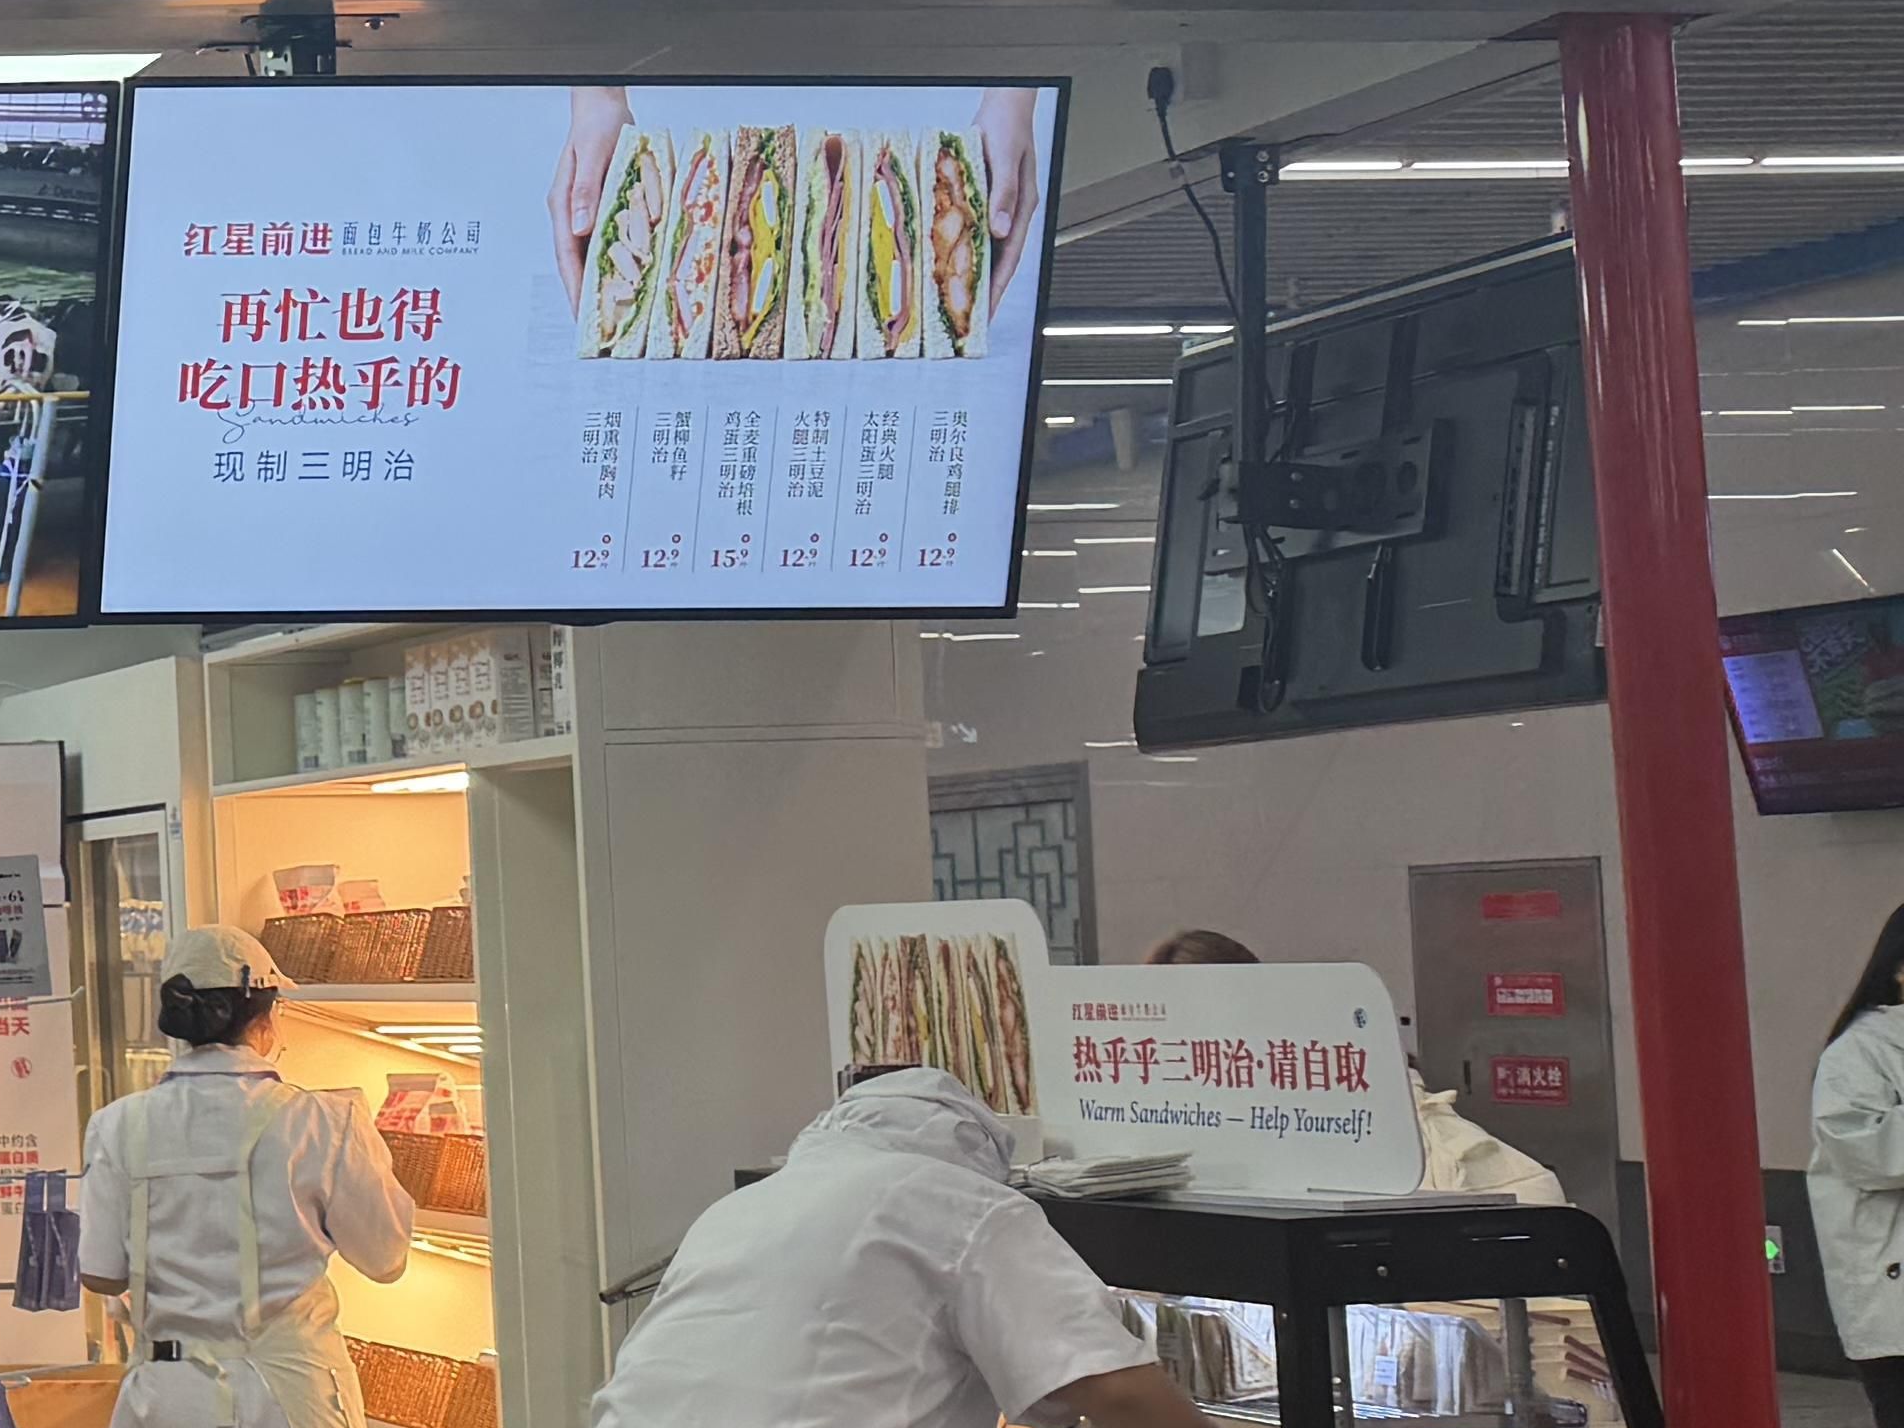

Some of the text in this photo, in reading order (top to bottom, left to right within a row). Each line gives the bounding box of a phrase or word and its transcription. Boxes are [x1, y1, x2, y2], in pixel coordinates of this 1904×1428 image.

[183, 221, 480, 256] 红星前进 面包牛奶公司
[217, 288, 443, 343] 再忙也得
[178, 356, 461, 410] 吃口热乎的
[217, 394, 419, 444] Sandwiches
[582, 413, 602, 463] 三明治
[652, 413, 672, 463] 三明治
[670, 411, 692, 481] 蟹柳鱼籽
[877, 411, 899, 481] 经典火腿
[929, 411, 950, 463] 三明治
[214, 449, 415, 482] 现制三明治
[599, 411, 622, 499] 烟熏鸡胸肉
[718, 411, 742, 499] 鸡蛋三明治
[736, 411, 761, 516] 全麦重磅培根
[788, 411, 811, 499] 火腿三明治
[807, 411, 830, 499] 特制土豆泥
[855, 411, 879, 516] 太阳蛋三明治
[943, 411, 968, 516] 奥尔良鸡腿排
[1073, 1003, 1118, 1021] 红星前进
[1073, 1036, 1370, 1092] 热乎乎三明治·请自取
[1517, 1067, 1562, 1086] 消火栓
[1080, 1099, 1125, 1122] Warm
[1130, 1101, 1221, 1128] Sandwiches
[1250, 1106, 1289, 1138] Help
[1293, 1108, 1372, 1143] Yourself!
